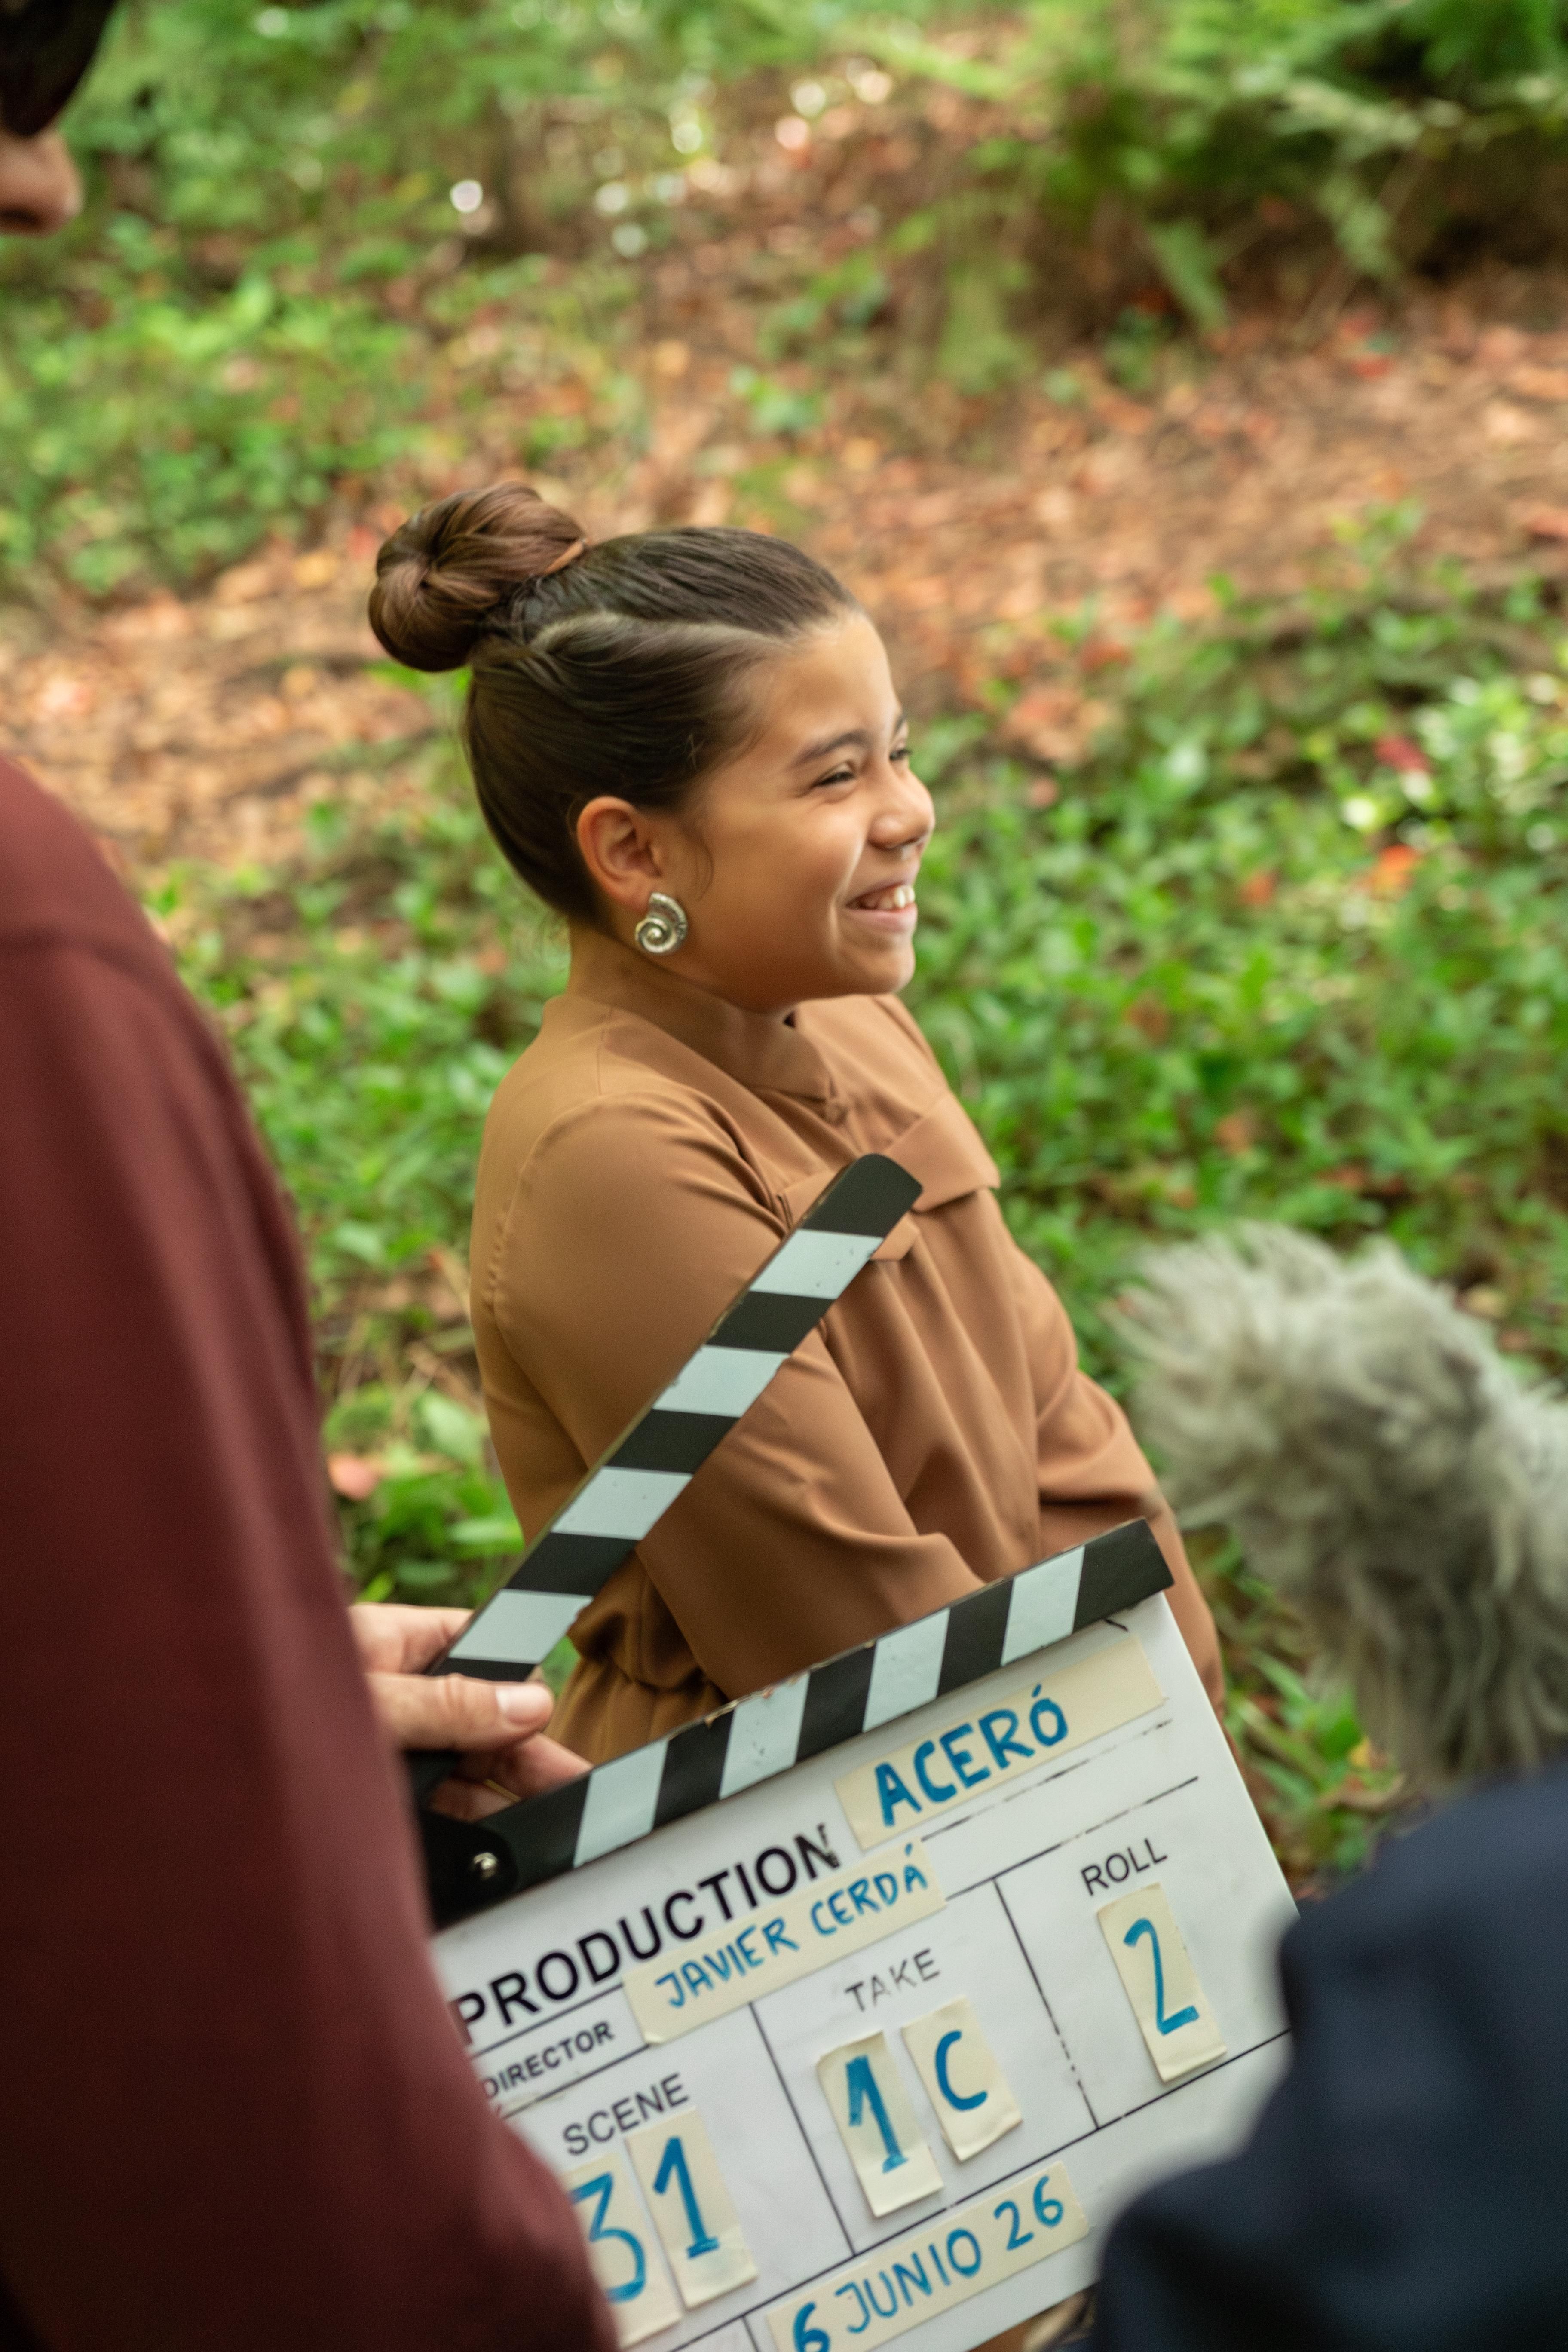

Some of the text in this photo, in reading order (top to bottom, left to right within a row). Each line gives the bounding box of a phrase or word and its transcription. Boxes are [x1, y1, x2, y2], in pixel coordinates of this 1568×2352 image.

[876, 1685, 1068, 1825] ACERÓ
[655, 1842, 928, 2008] JAVIER CERDÁ
[1081, 1838, 1167, 1896] ROLL
[450, 1824, 841, 2045] PRODUCTION
[845, 1949, 939, 2011] TAKE
[1124, 1919, 1199, 2035] 2
[481, 2021, 615, 2099] DIRECTOR
[563, 2073, 689, 2156] SCENE
[834, 2228, 982, 2334] JUNIO
[993, 2175, 1064, 2251] 26
